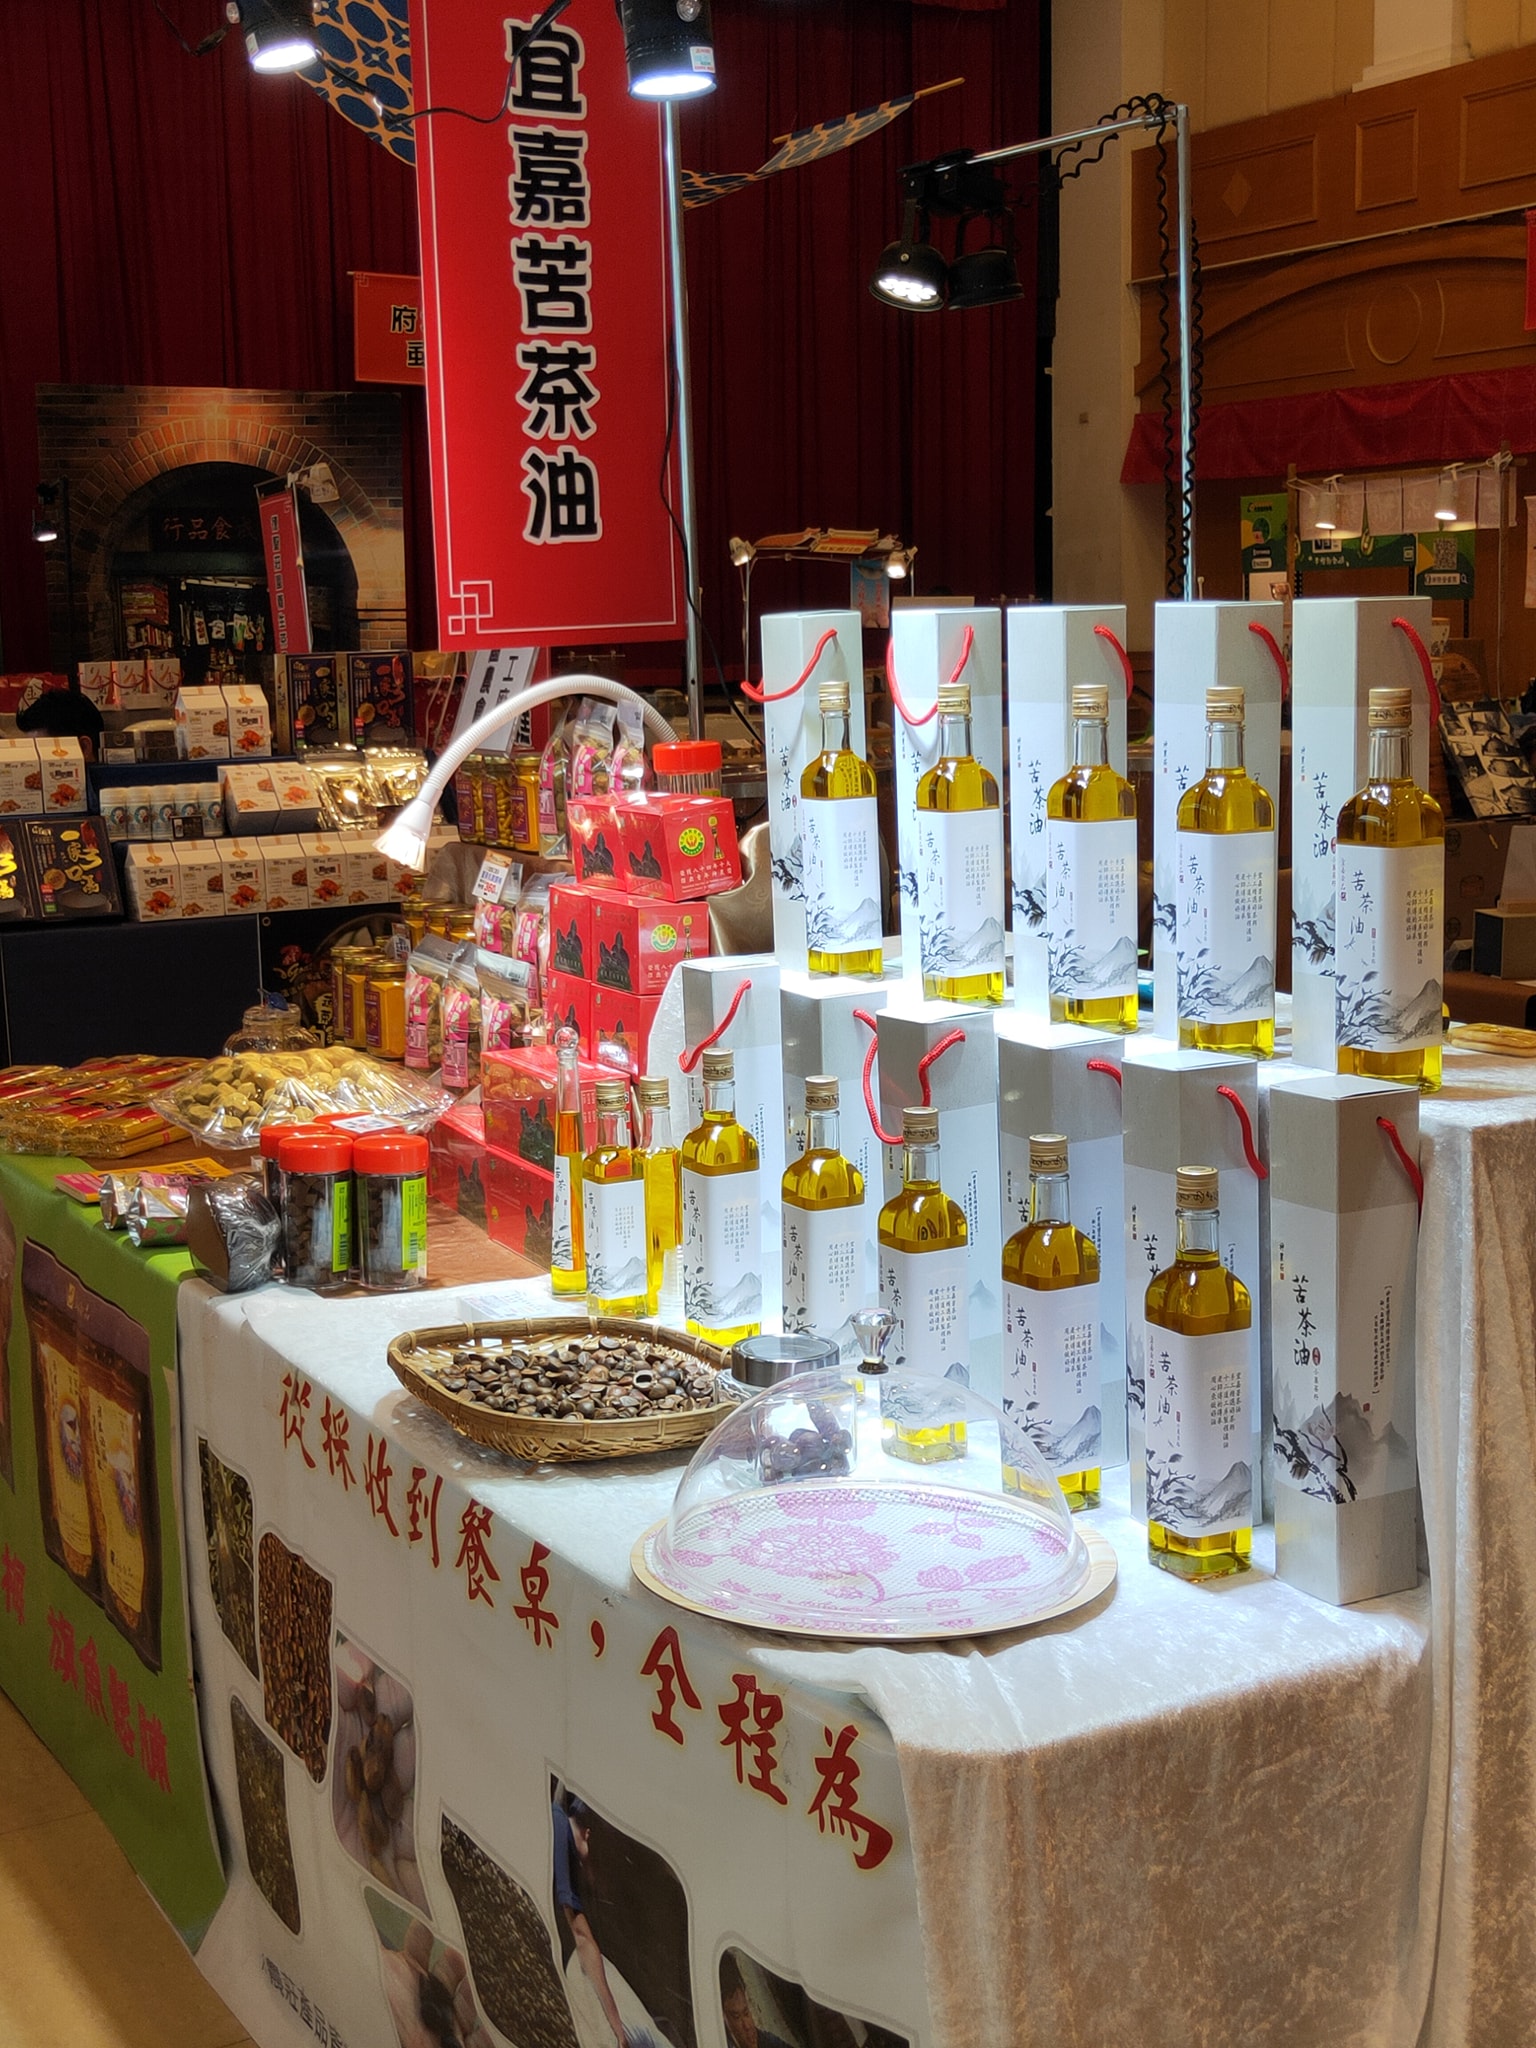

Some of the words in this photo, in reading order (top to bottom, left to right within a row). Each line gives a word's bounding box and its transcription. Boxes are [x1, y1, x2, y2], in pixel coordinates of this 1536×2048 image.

[503, 14, 602, 546] 宜嘉苦茶油
[780, 745, 794, 811] 苦茶油
[1028, 760, 1046, 836] 苦茶油
[1312, 772, 1335, 858] 苦茶油
[1055, 841, 1071, 898] 苦茶油
[1187, 855, 1205, 915] 苦茶油
[1350, 870, 1375, 937] 苦茶油
[1015, 1306, 1034, 1366] 苦茶油
[1292, 1274, 1317, 1367] 苦茶油
[1158, 1351, 1179, 1415] 苦茶油
